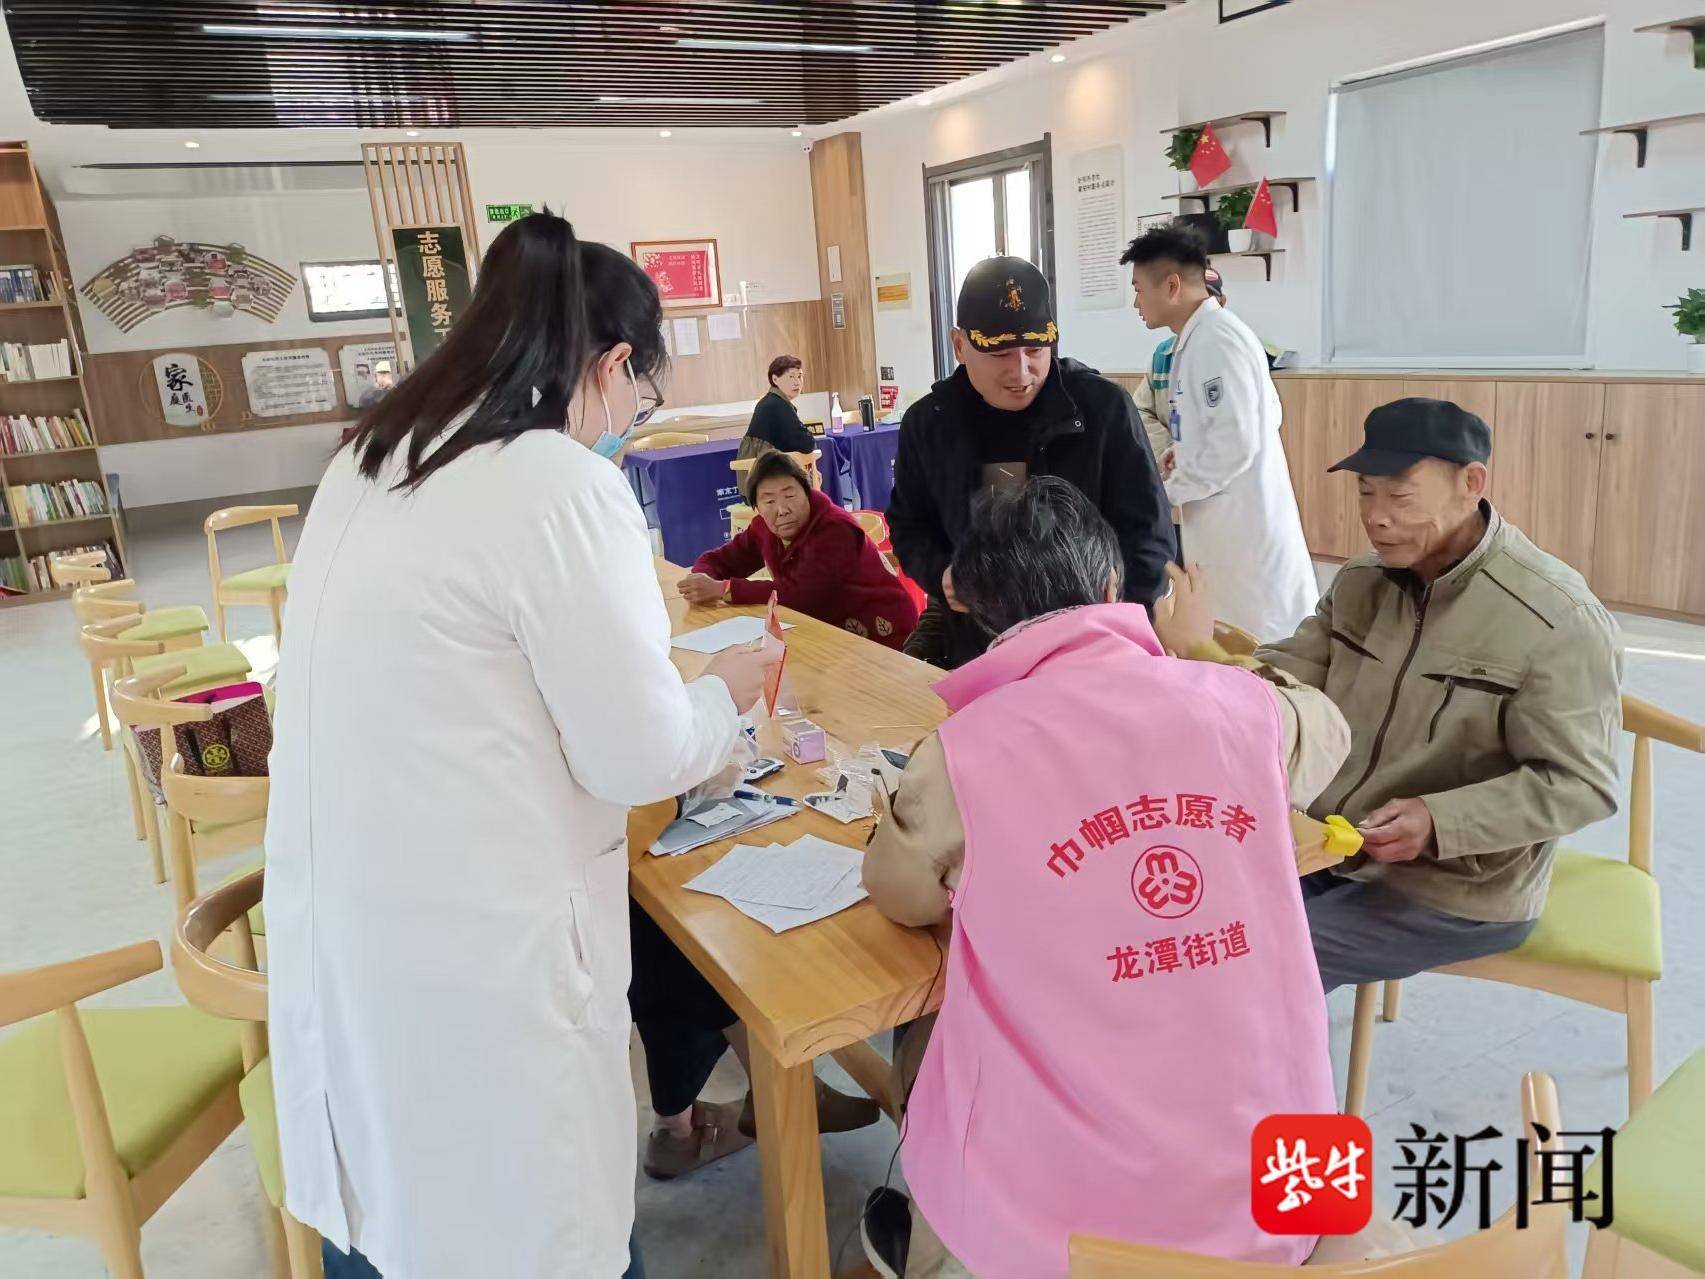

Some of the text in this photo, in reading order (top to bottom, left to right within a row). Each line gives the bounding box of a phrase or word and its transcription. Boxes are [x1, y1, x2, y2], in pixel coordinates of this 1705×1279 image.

[1046, 793, 1257, 878] 巾帼志愿者
[1106, 921, 1250, 982] 龙潭街道
